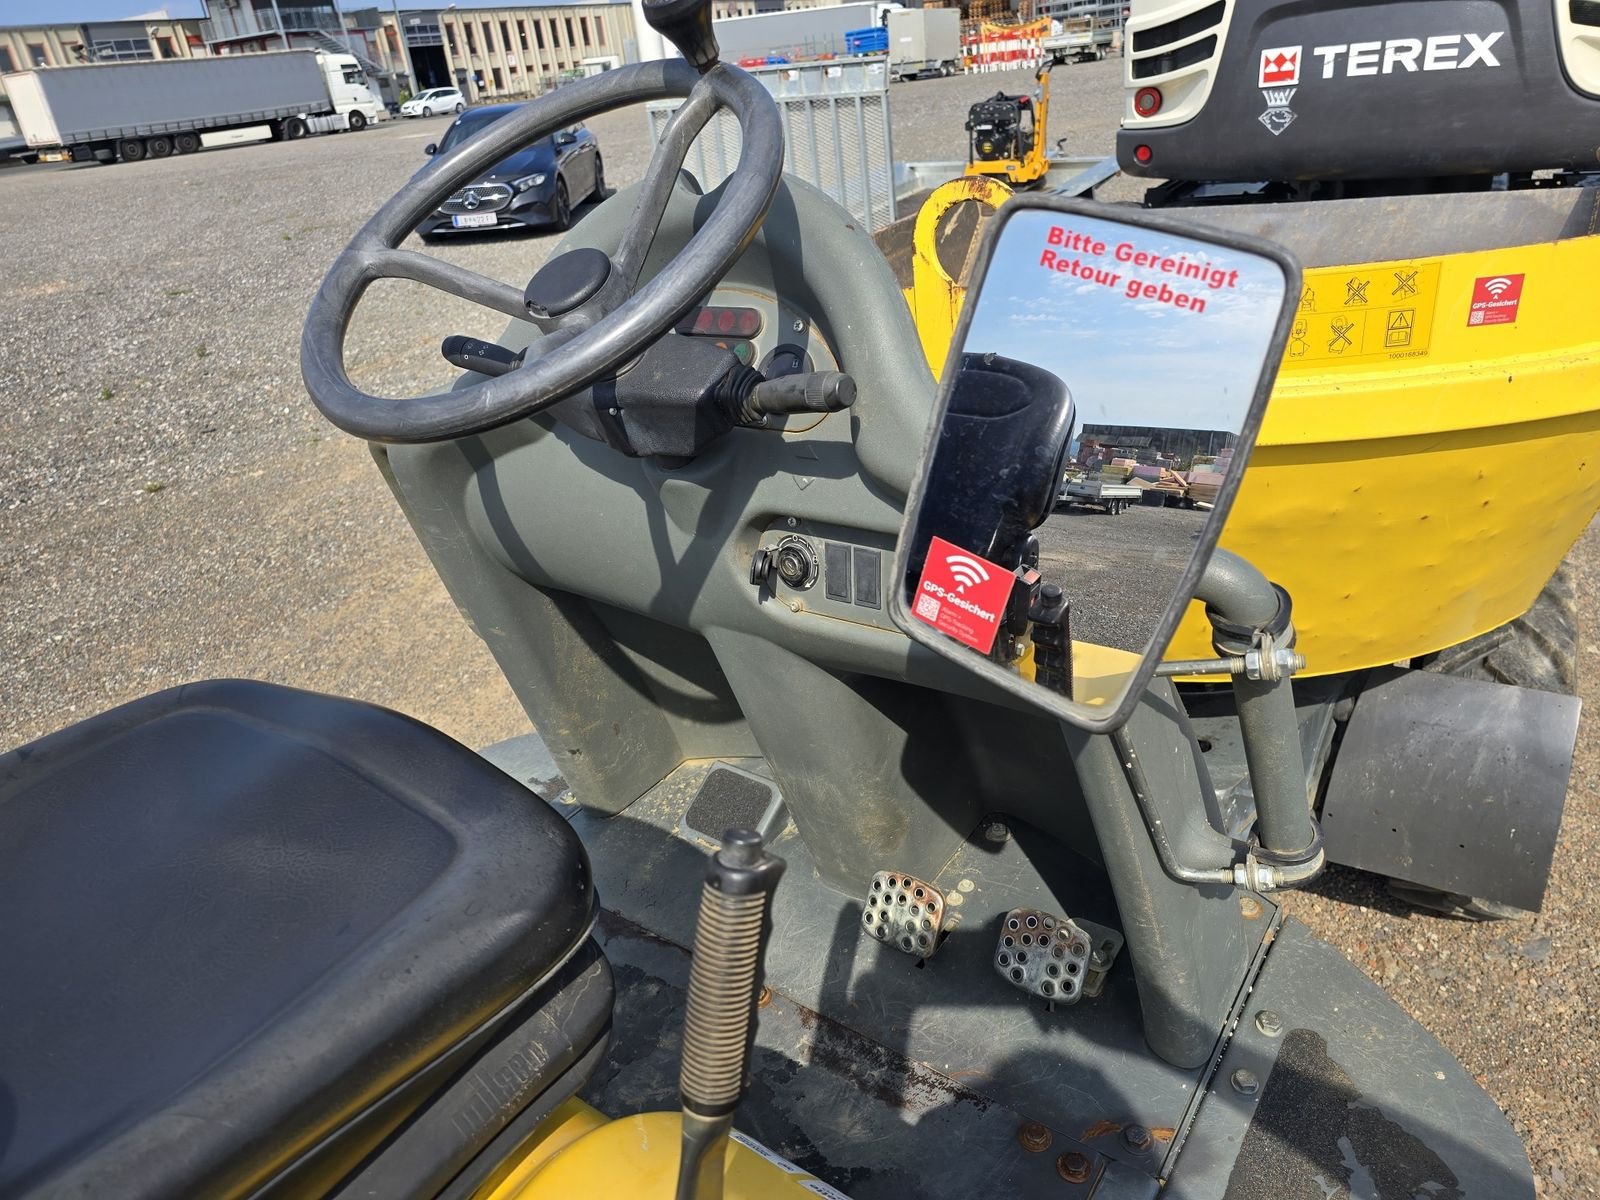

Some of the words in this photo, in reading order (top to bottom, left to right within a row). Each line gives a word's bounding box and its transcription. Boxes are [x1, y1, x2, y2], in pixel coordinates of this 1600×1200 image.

[1313, 31, 1505, 80] TEREX
[1039, 249, 1122, 288] Retour
[1125, 279, 1207, 314] geben
[1047, 226, 1106, 256] Bitte
[1115, 243, 1239, 289] Gereinigt
[1472, 298, 1518, 309] GPS-Gesichert
[923, 580, 996, 623] GPS-Gesichert
